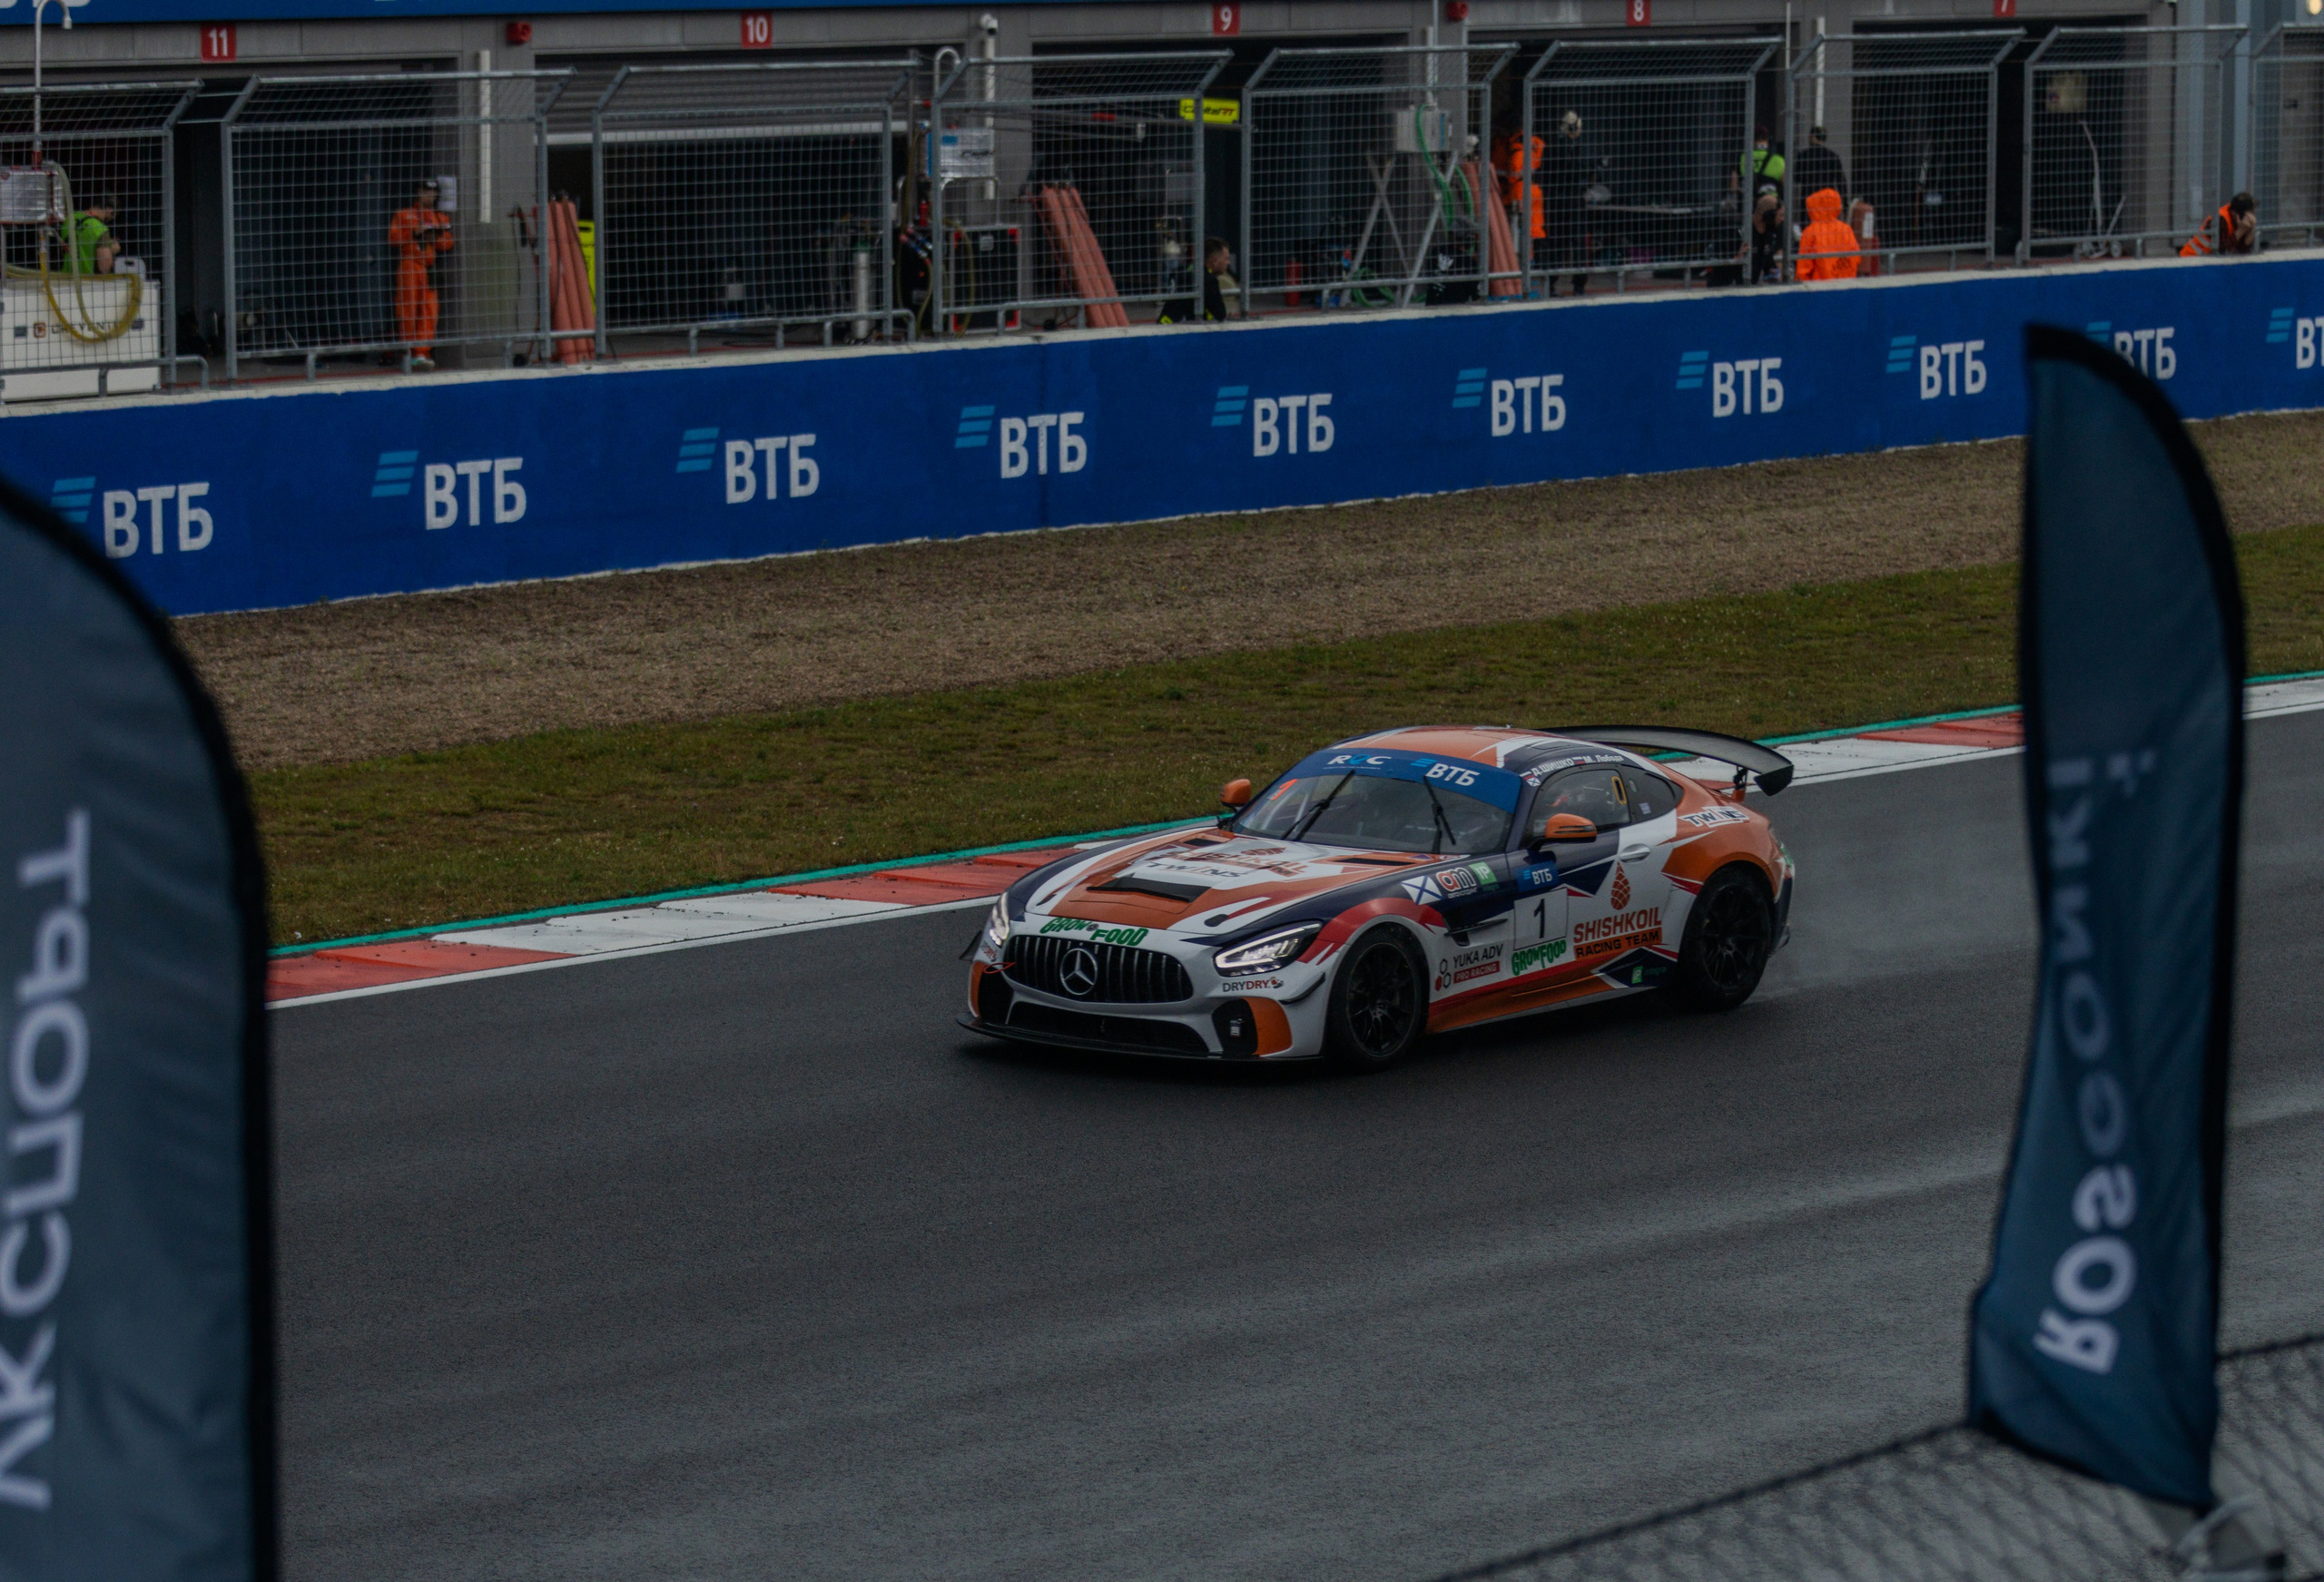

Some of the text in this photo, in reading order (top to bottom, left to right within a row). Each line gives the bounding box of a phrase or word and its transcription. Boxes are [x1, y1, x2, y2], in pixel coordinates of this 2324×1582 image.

[1221, 5, 1232, 32] 9
[1633, 0, 1644, 22] 8
[209, 27, 228, 56] 11
[745, 15, 768, 44] 10
[1920, 339, 1988, 400] ВТБ
[2113, 326, 2177, 380] ВТБ
[1712, 357, 1785, 418] ВТБ
[1491, 373, 1566, 437] ВТБ
[1253, 393, 1334, 457] ВТБ
[1000, 411, 1088, 479] ВТБ
[724, 433, 820, 504] ВТБ
[424, 457, 527, 531] ВТБ
[103, 481, 214, 559] ВТБ
[1270, 778, 1298, 801] 1
[1425, 762, 1481, 787] ВТБ
[1531, 868, 1553, 886] ВТБ
[1533, 898, 1545, 939] 1
[1573, 907, 1662, 944] SHISHKOIL
[1089, 928, 1149, 947] FOOD
[1576, 929, 1659, 958] RACING TEAM
[1453, 943, 1503, 968] YUKA ADV
[1455, 963, 1498, 982] PRO RACING
